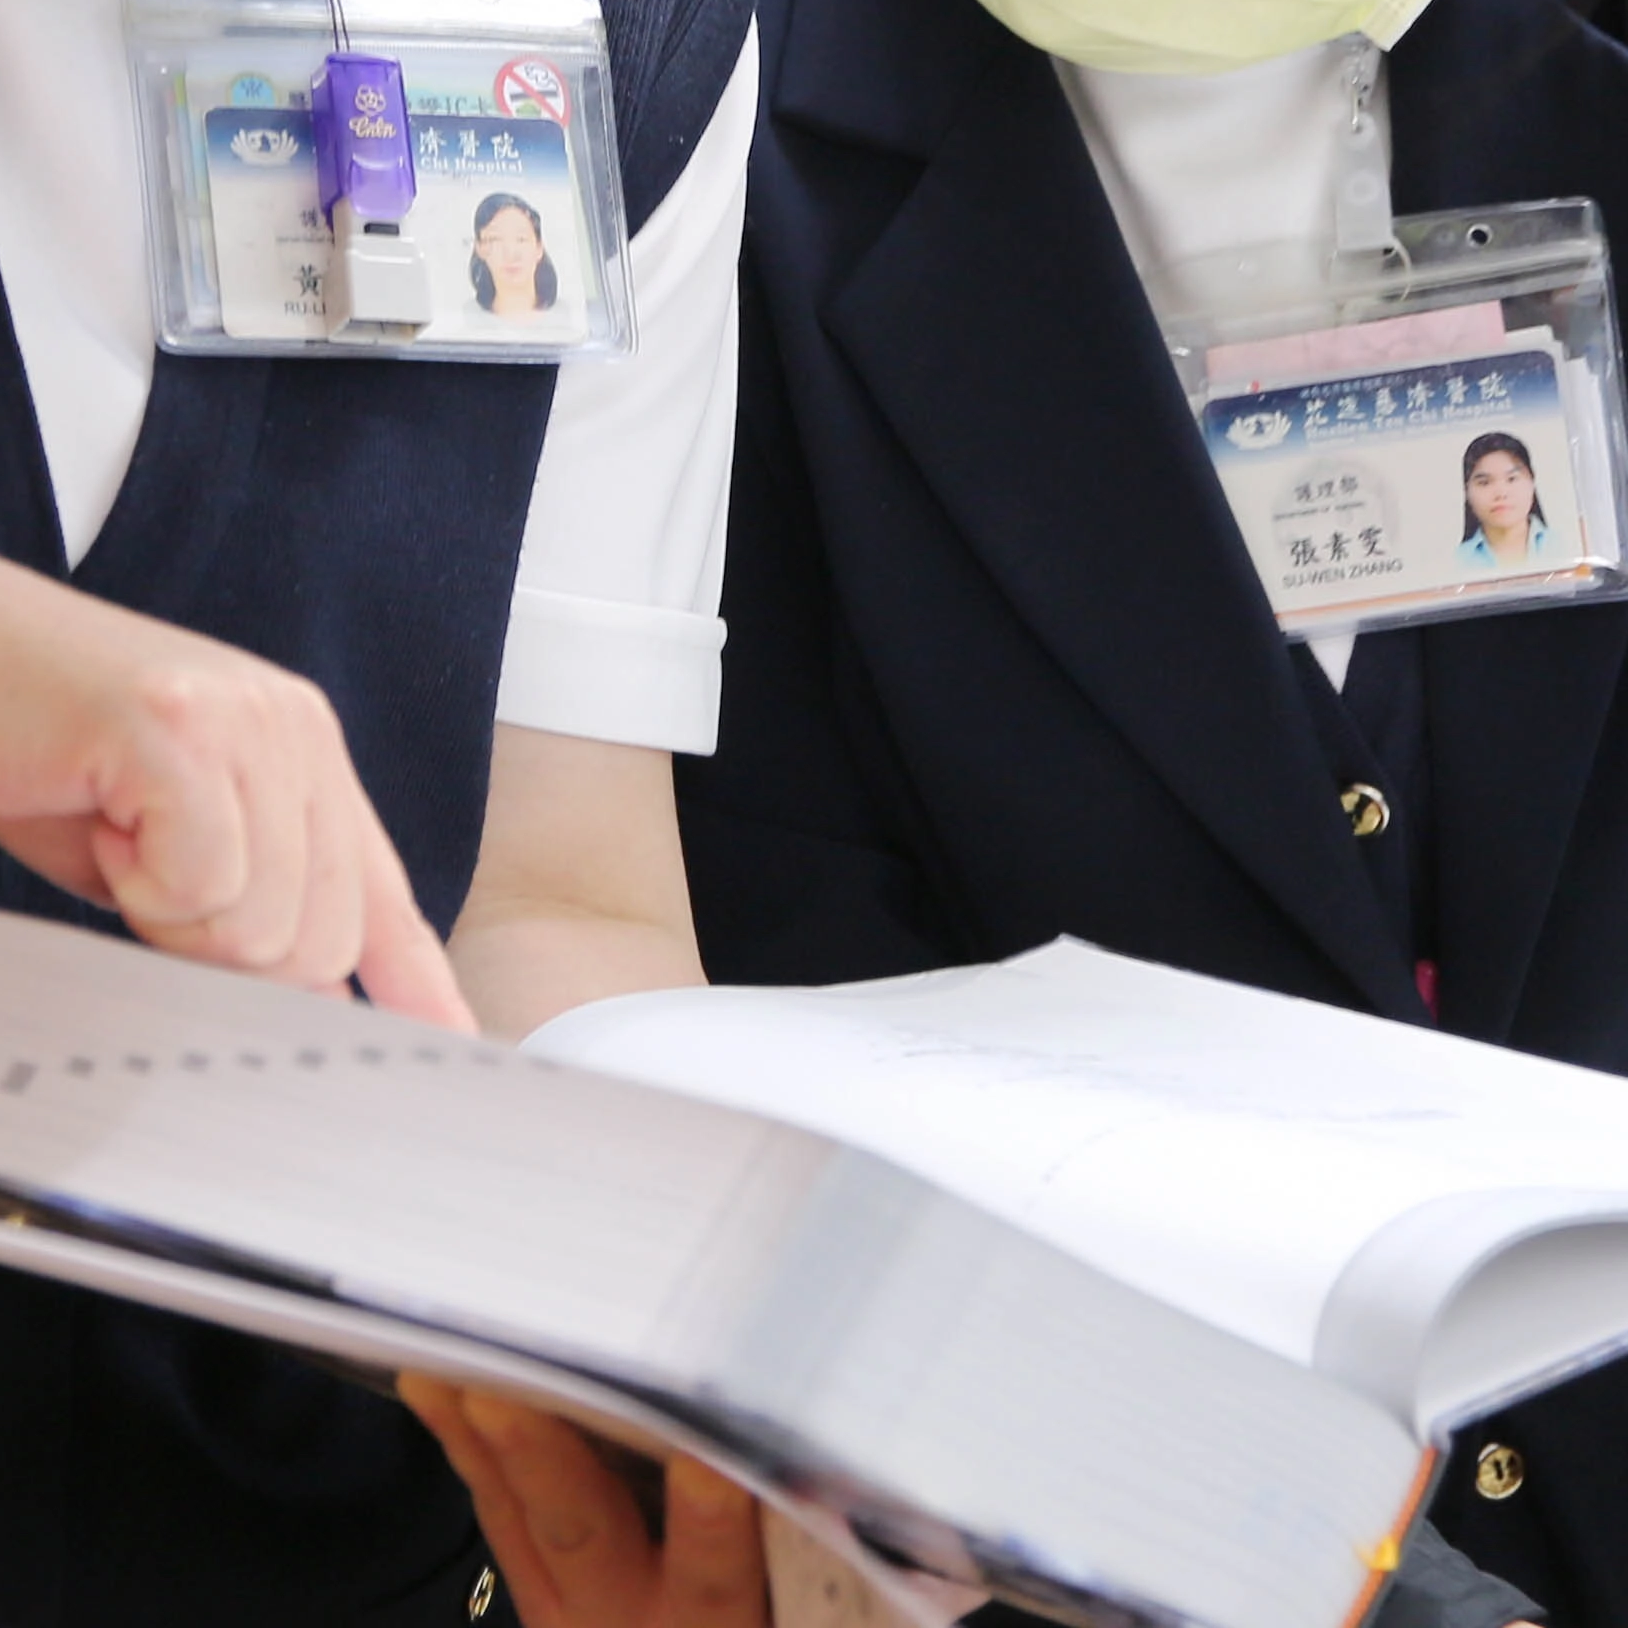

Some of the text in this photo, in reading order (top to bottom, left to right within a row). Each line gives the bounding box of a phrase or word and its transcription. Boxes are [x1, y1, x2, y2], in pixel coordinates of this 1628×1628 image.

[455, 157, 522, 174] Hospital
[1442, 397, 1512, 421] Hospital
[1348, 558, 1404, 580] ZHANG
